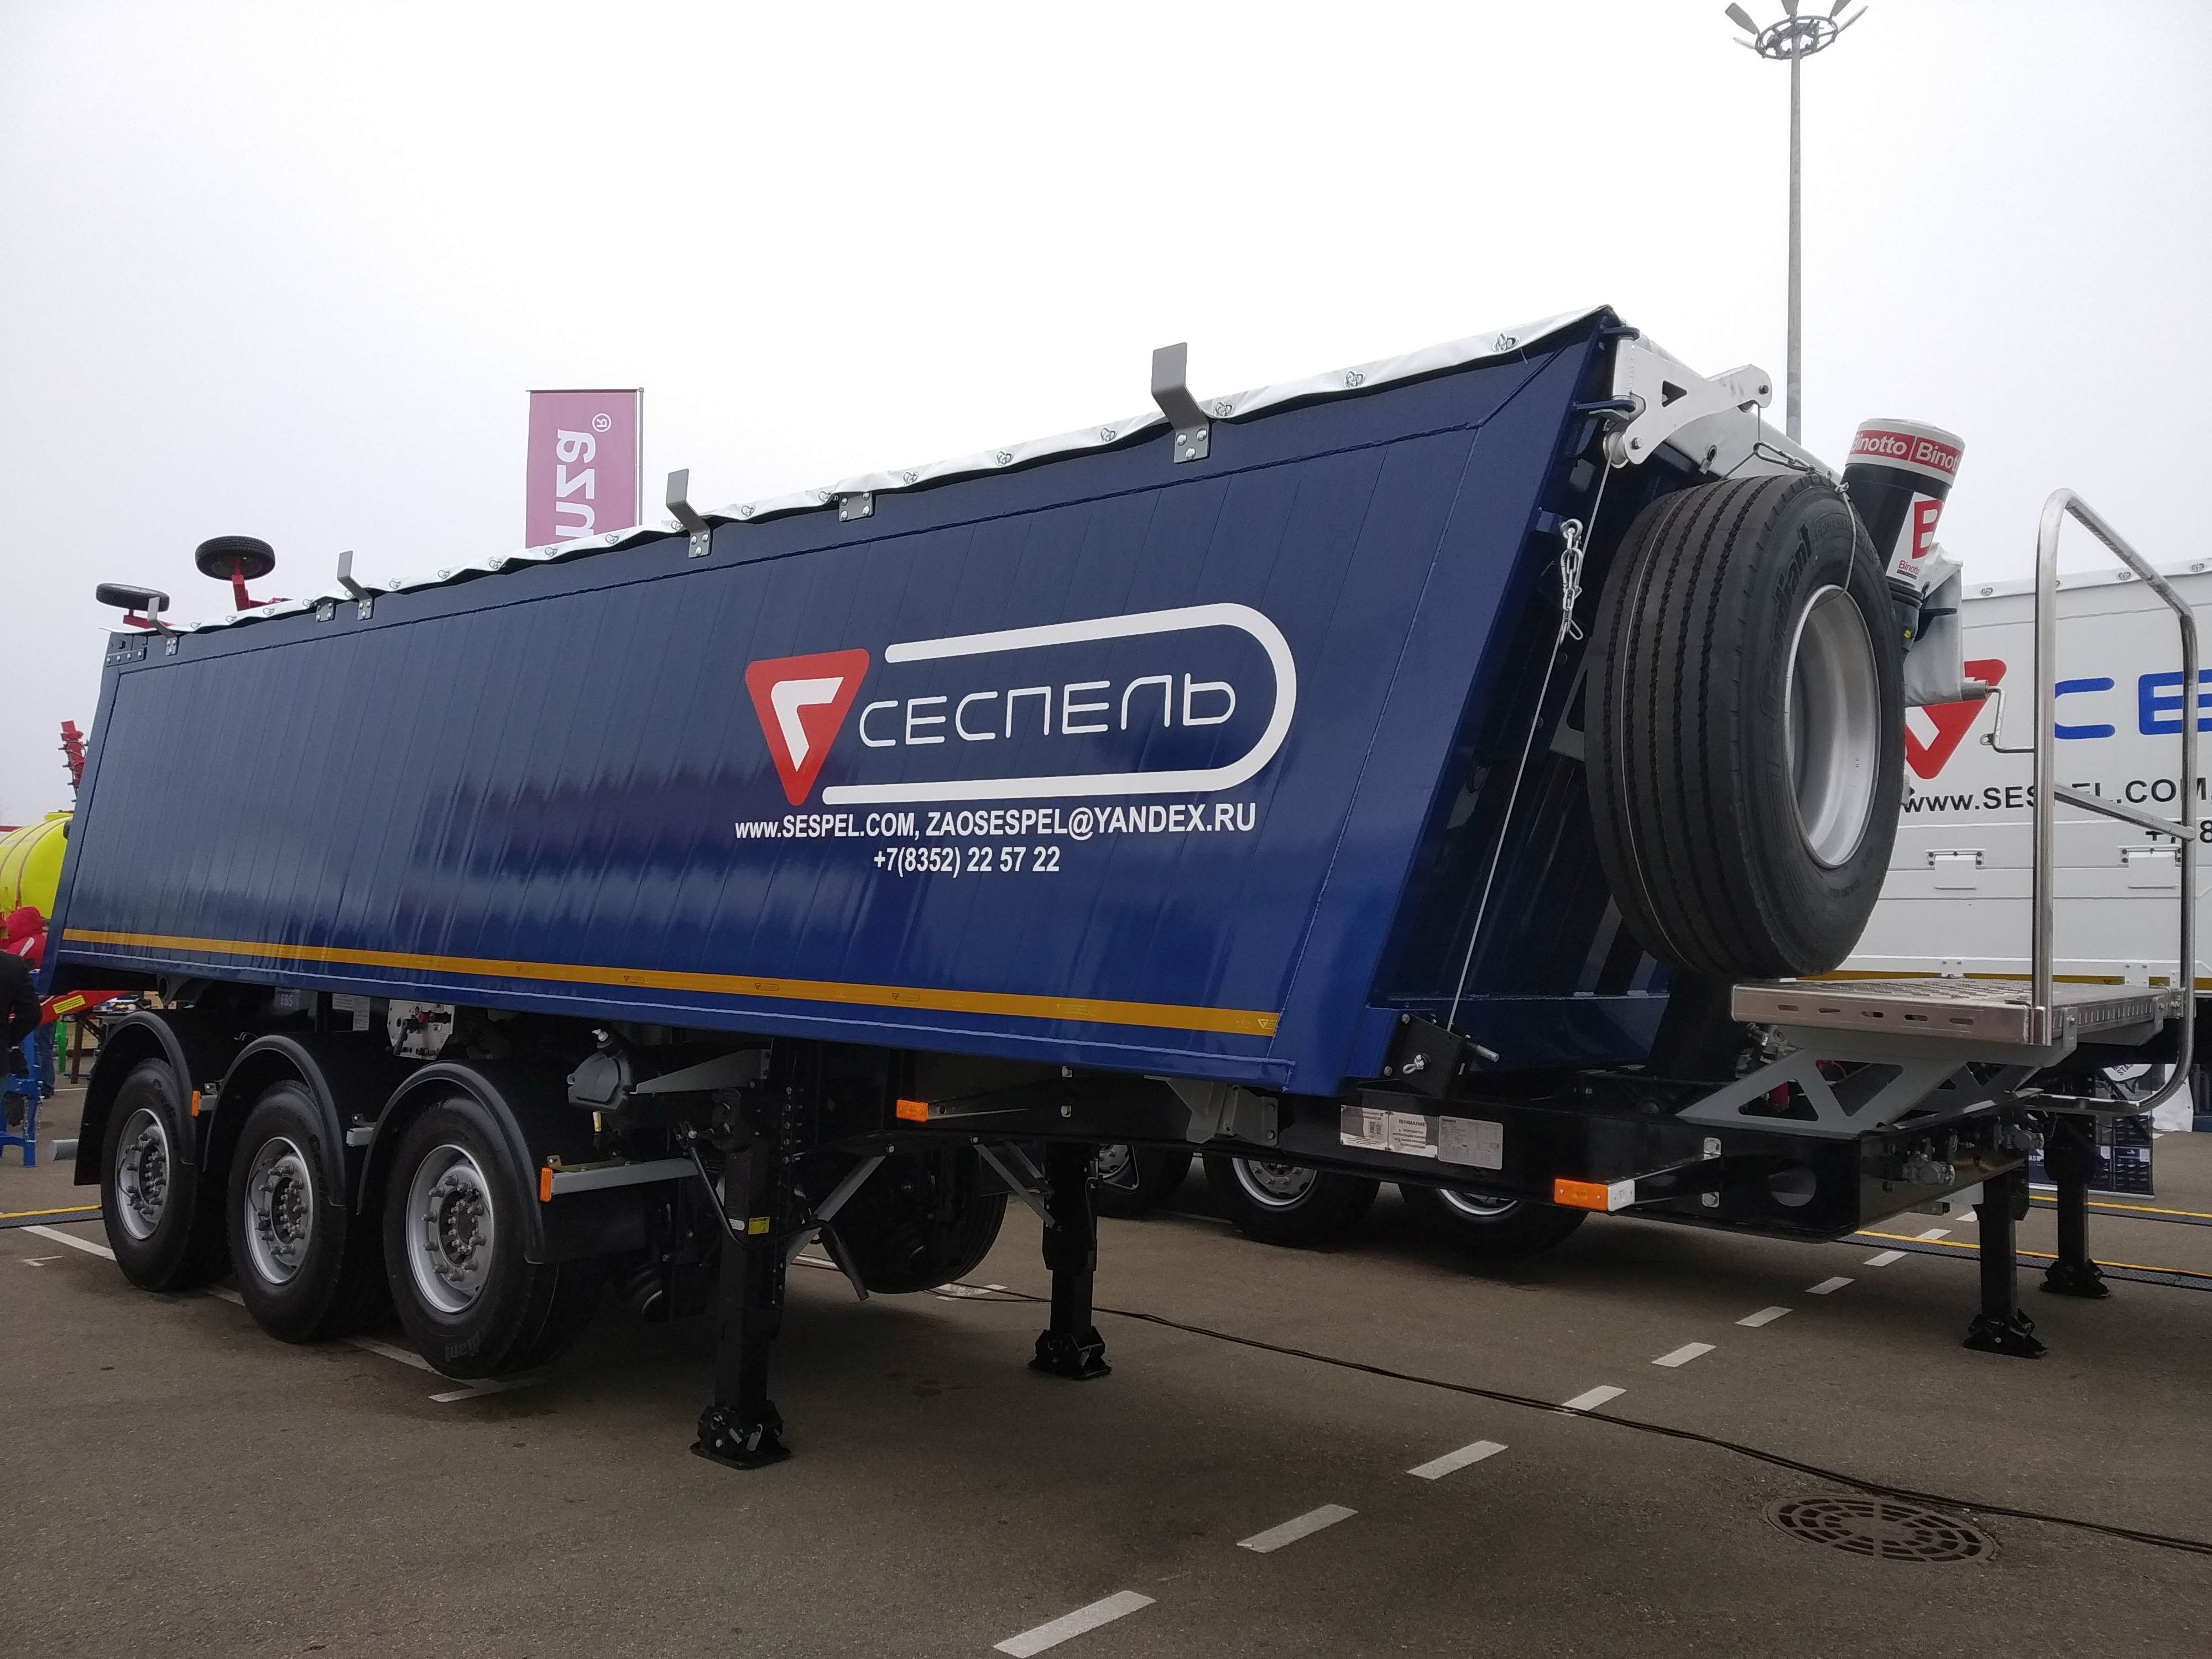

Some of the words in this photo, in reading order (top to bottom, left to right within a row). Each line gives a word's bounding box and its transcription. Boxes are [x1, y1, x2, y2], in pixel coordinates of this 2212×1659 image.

[1851, 434, 1907, 456] Binotto
[859, 672, 1236, 747] СЕСПЕЛЬ
[735, 812, 920, 841] www.SESPEL.COM,
[926, 802, 1256, 841] ZAOSESPEL@YANDEX.RU
[874, 847, 961, 878] +7(8352)
[967, 847, 993, 872] 22
[999, 847, 1026, 872] 57
[1032, 846, 1060, 872] 22
